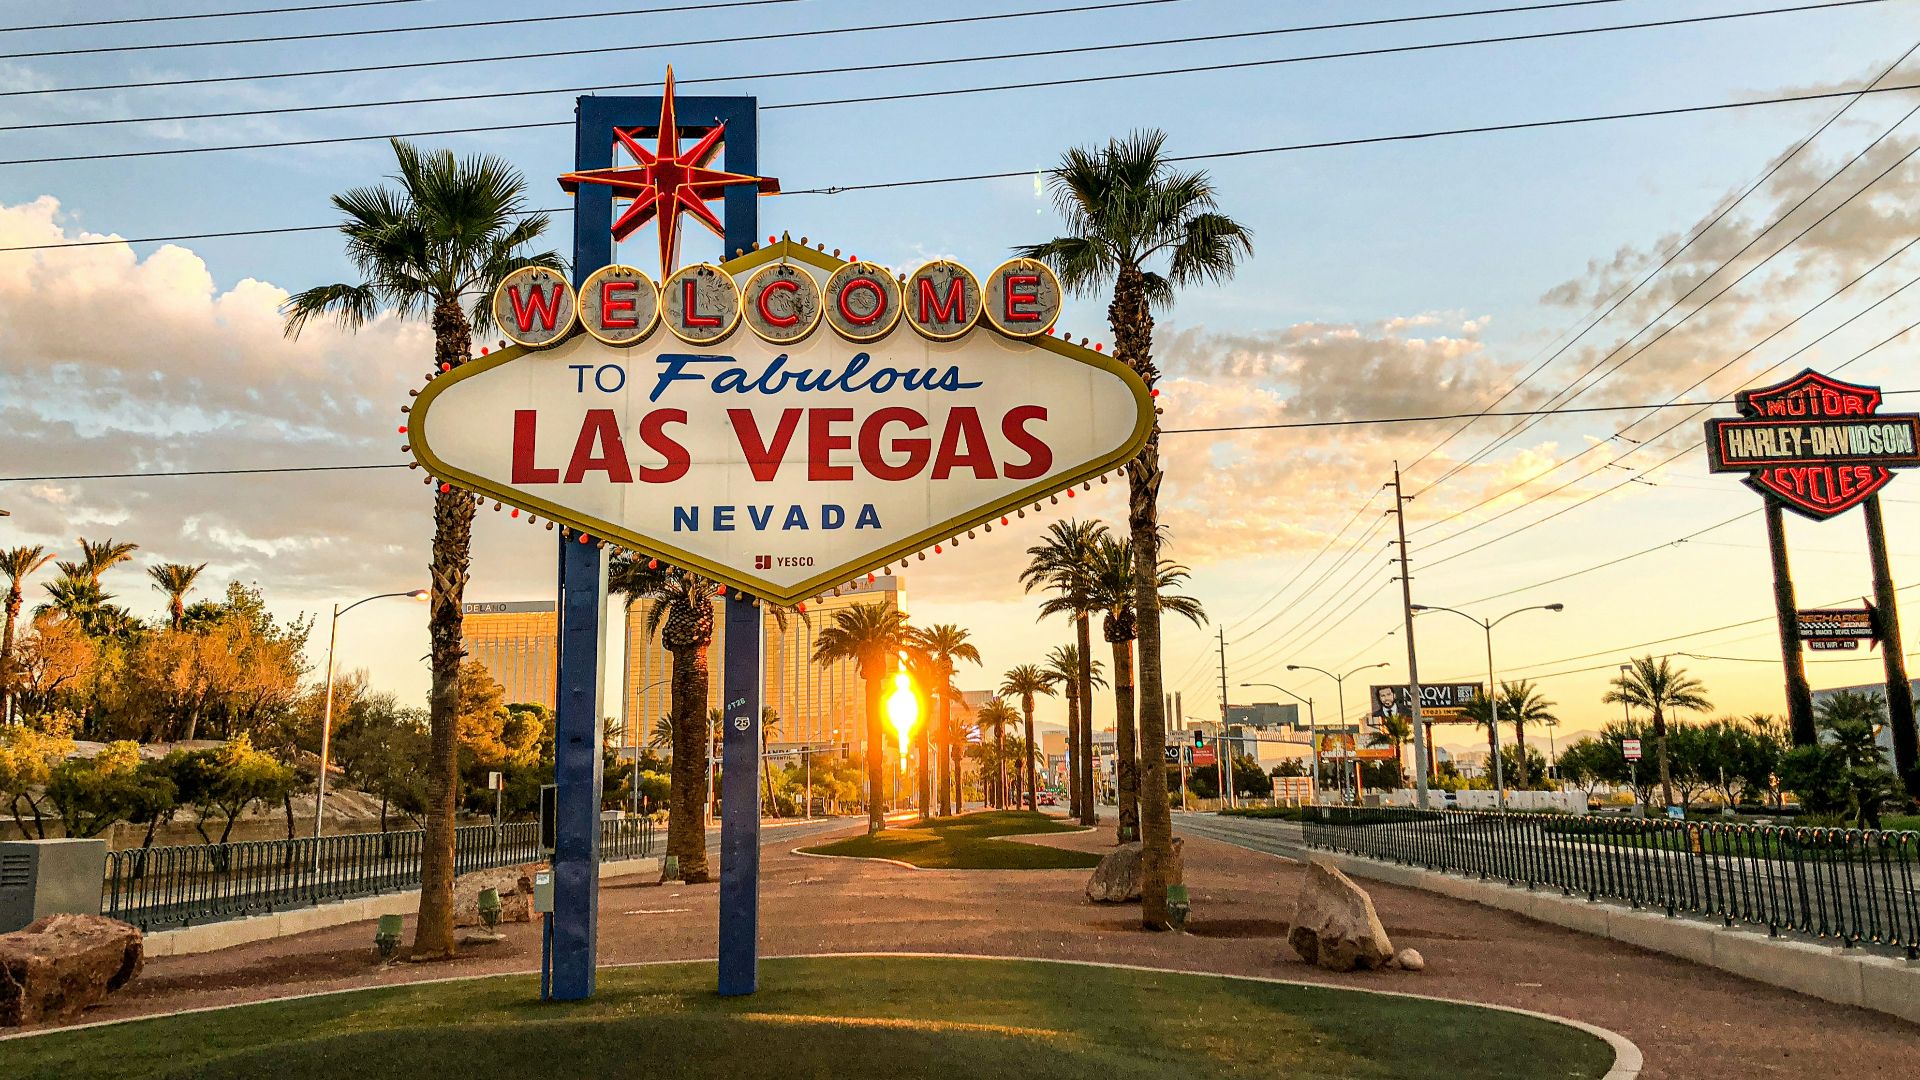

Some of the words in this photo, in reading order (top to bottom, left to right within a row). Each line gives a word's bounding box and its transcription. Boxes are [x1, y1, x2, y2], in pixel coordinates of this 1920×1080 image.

[507, 274, 1041, 333] WELCOME
[568, 364, 626, 393] TO
[649, 352, 983, 403] Fabulous
[1767, 382, 1865, 416] MOTOR
[511, 407, 691, 484] LAS
[726, 404, 1053, 482] VEGAS
[1728, 424, 1914, 458] HARLEY-DAVIDSON
[1775, 465, 1874, 504] CYCLES
[673, 503, 882, 532] NEVADA
[777, 556, 815, 567] YESCO
[736, 719, 748, 727] 25
